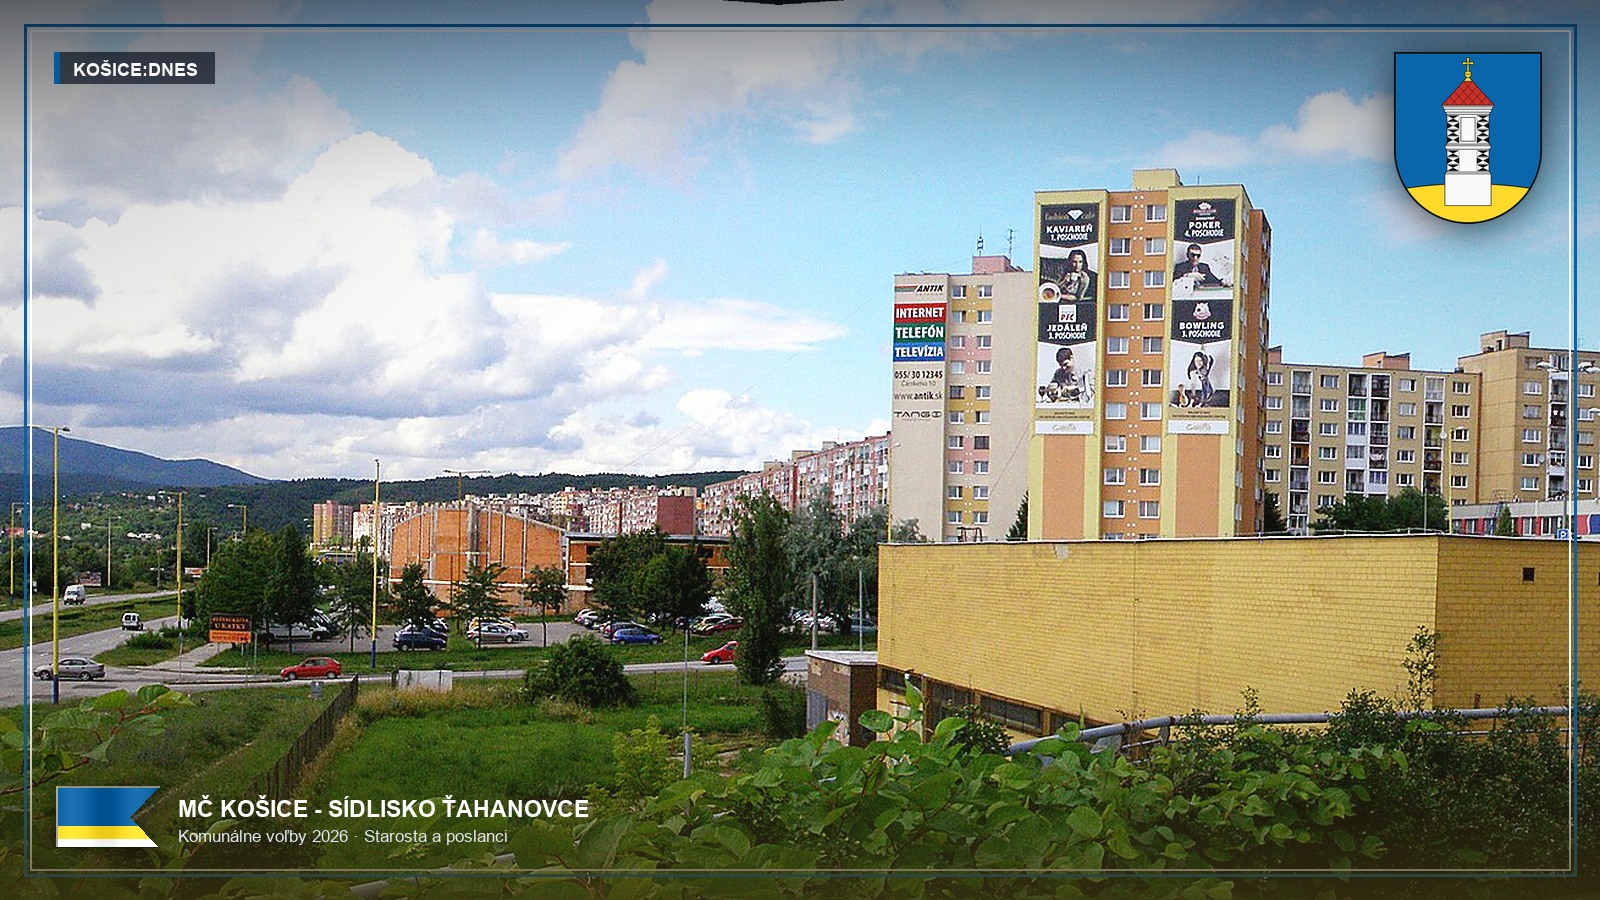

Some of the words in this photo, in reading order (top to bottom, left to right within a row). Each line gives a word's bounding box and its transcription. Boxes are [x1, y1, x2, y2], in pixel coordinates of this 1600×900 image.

[1046, 223, 1093, 234] KAVIAREŇ
[1188, 221, 1221, 229] POKER
[916, 284, 945, 292] ANTIK
[895, 307, 945, 319] INTERNET
[1046, 323, 1088, 332] JEDÁLEŇ
[1179, 321, 1225, 330] BOWLING
[895, 324, 944, 339] TELEFÓN
[894, 344, 944, 358] TELEVÍZIA
[911, 370, 921, 379] 30
[922, 370, 943, 379] 12345
[894, 391, 943, 400] www.antik.sk
